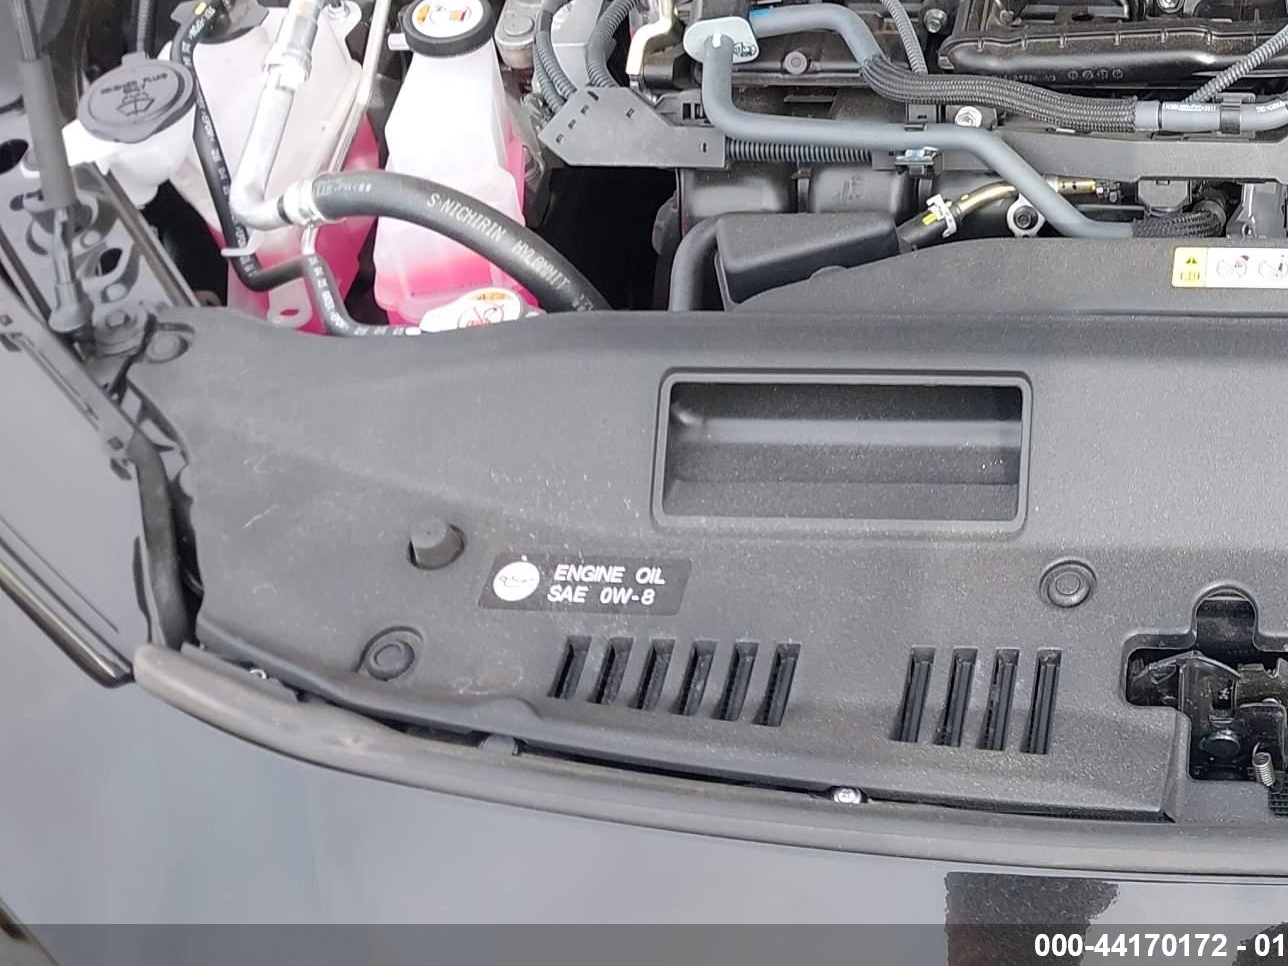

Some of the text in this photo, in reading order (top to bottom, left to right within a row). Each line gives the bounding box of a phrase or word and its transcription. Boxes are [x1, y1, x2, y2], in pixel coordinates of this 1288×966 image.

[553, 563, 666, 585] ENGINE OIL
[546, 583, 655, 606] SAE 0W-8
